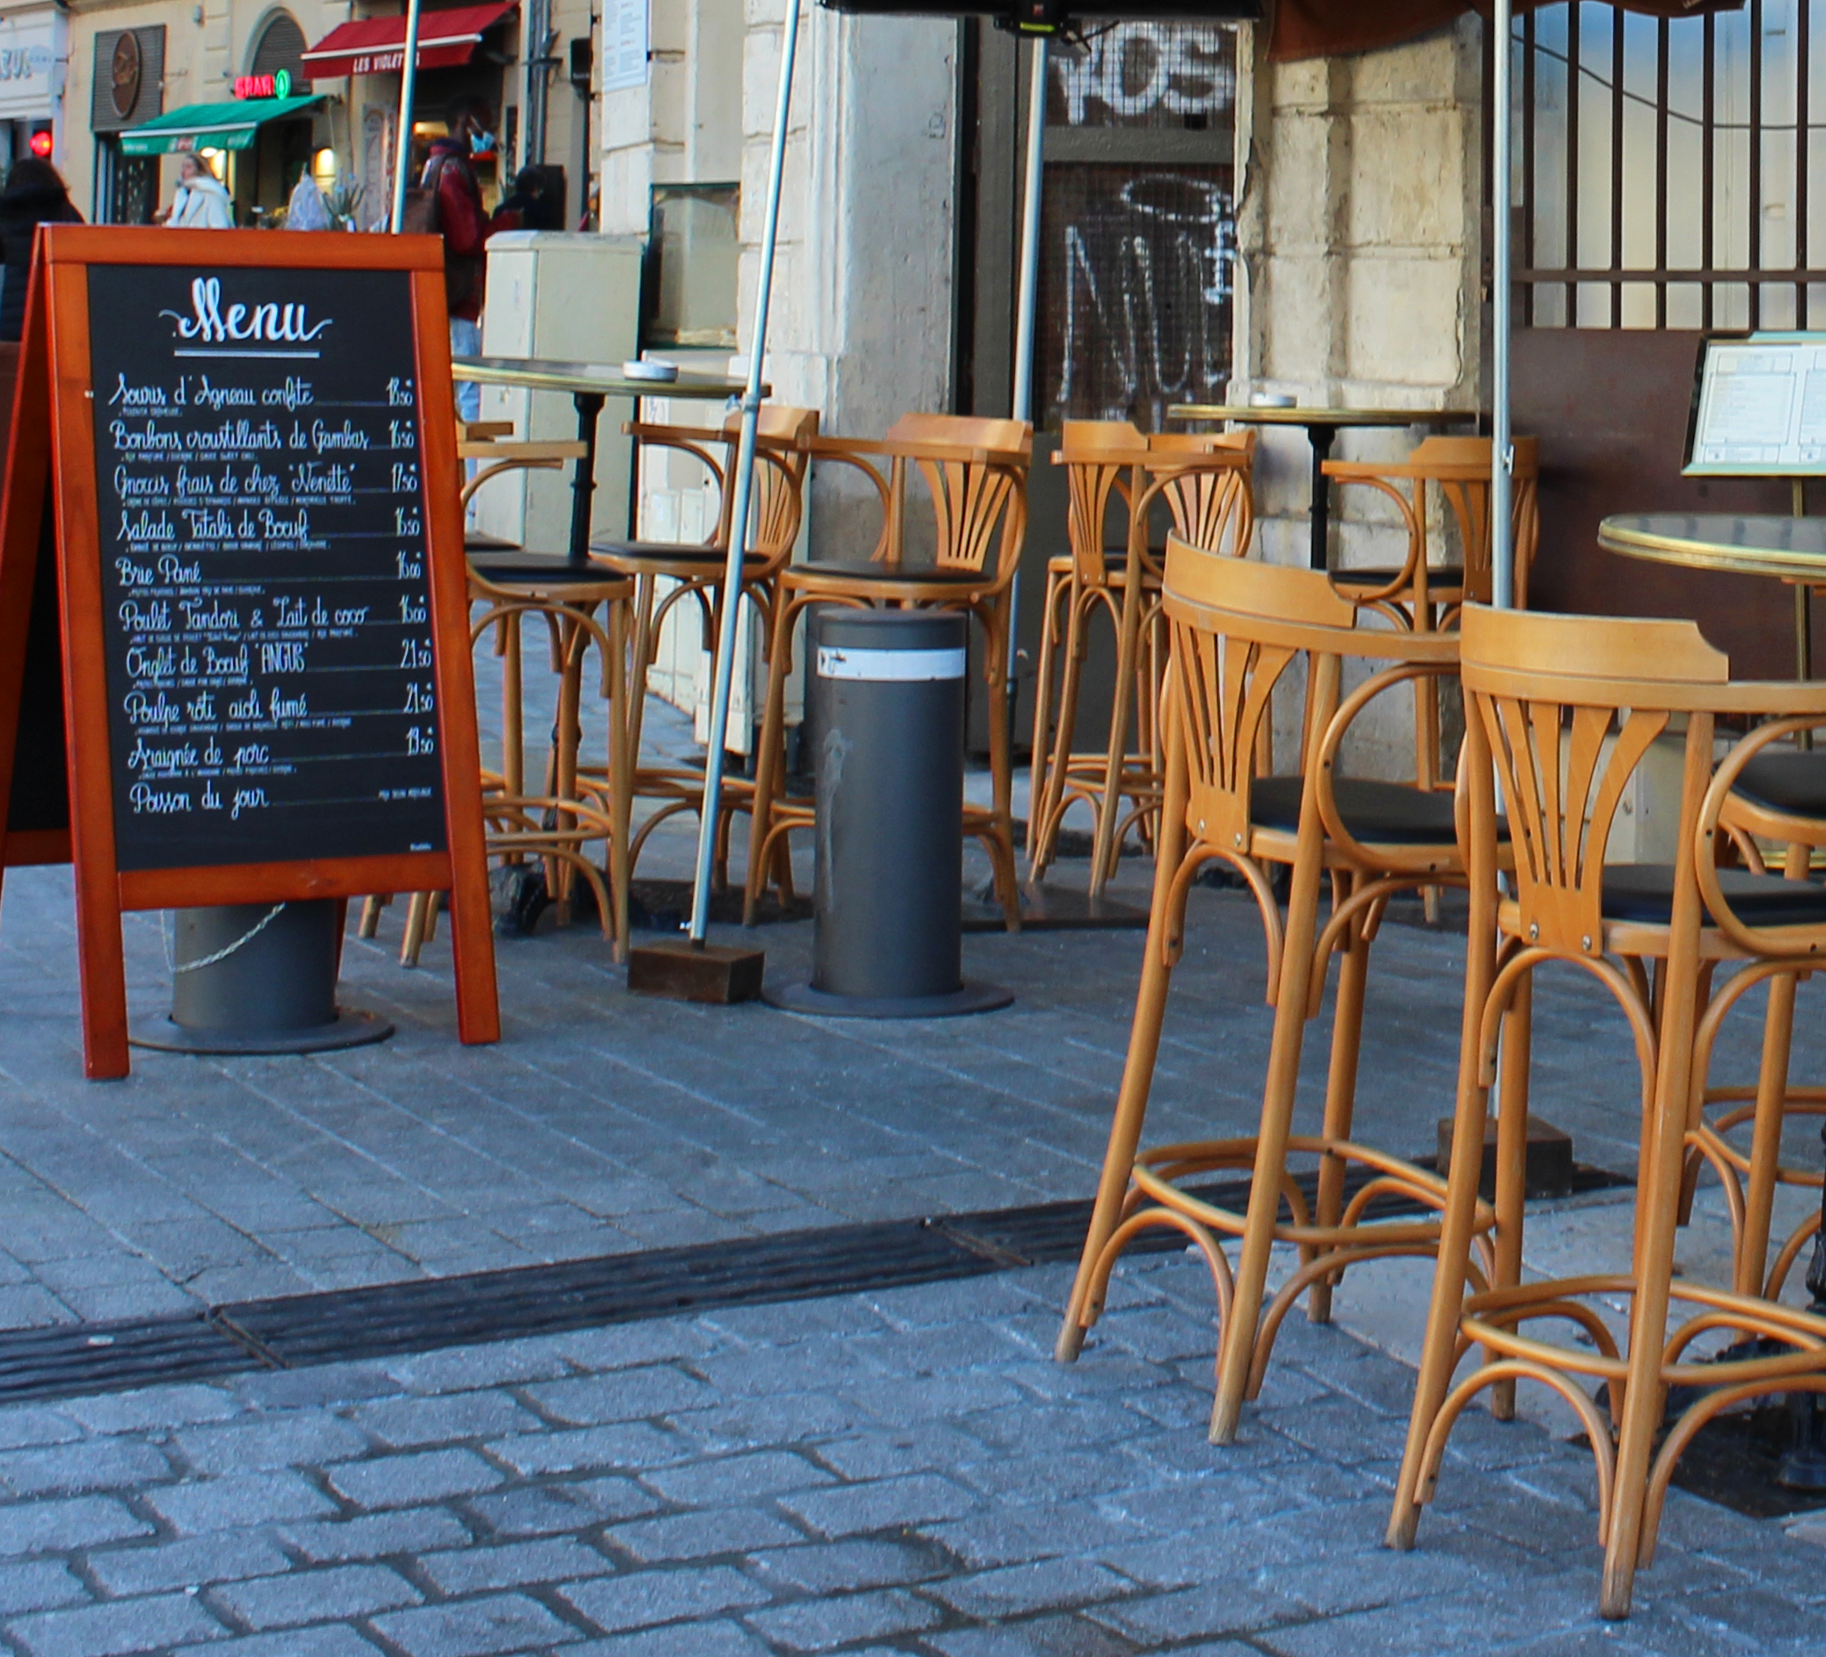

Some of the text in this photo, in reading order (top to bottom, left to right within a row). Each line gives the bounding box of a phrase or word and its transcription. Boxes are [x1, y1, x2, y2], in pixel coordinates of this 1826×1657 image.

[353, 52, 420, 73] LES VIOLETS
[158, 277, 333, 342] Menu
[108, 372, 166, 406] Souris
[110, 419, 182, 450] Bonbons
[186, 419, 282, 449] croustillants
[289, 420, 307, 449] de
[312, 418, 370, 454] Gambas
[176, 464, 214, 498] frais
[220, 464, 239, 493] de
[244, 463, 280, 497] chez
[116, 509, 175, 541] Salade
[182, 508, 235, 539] Tataki
[238, 508, 256, 539] de
[115, 556, 154, 586] Brie
[158, 553, 202, 584] Pané
[119, 599, 172, 632] Poulet
[178, 596, 240, 630] Tandori
[250, 608, 263, 628] &
[272, 596, 308, 628] Lait
[311, 595, 329, 626] de
[334, 606, 370, 625] coco
[126, 646, 177, 683] Onglet
[180, 645, 198, 675] de
[124, 690, 181, 730] Poulpe
[269, 687, 309, 722] fumé
[128, 737, 199, 771] Araignée
[204, 736, 223, 766] de
[234, 743, 270, 771] porc
[201, 780, 224, 809] du
[231, 787, 270, 821] jour
